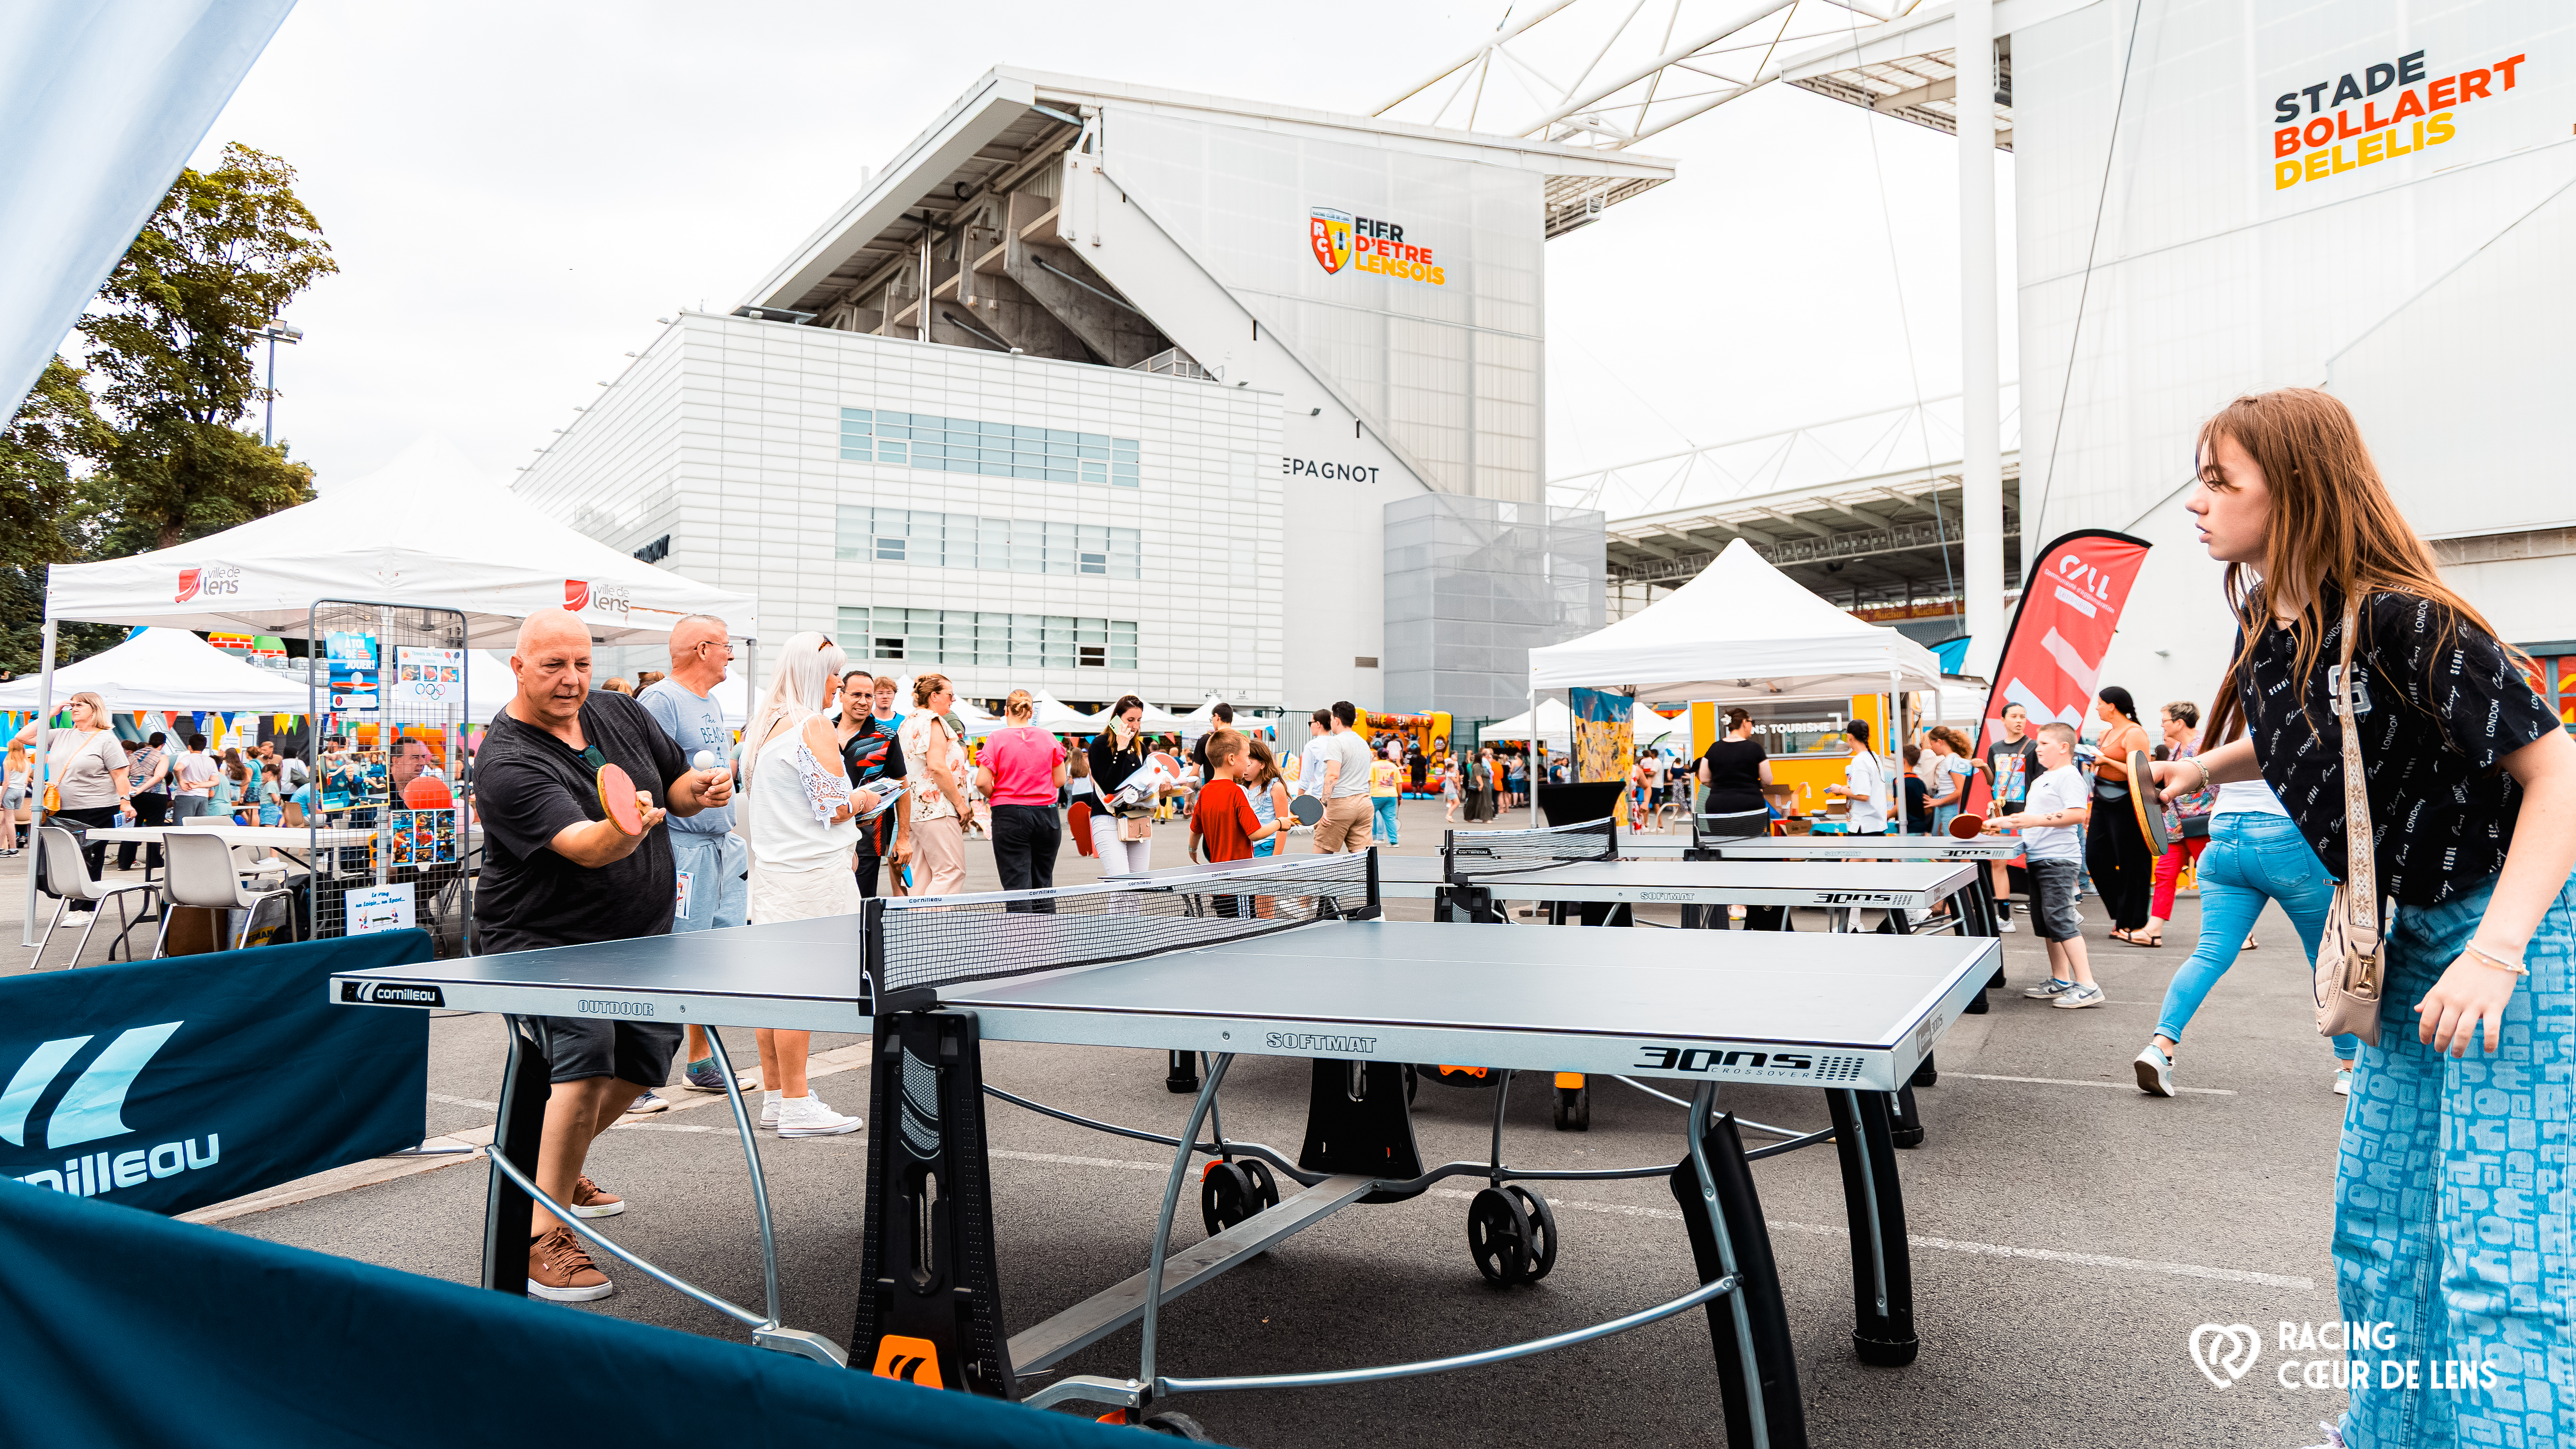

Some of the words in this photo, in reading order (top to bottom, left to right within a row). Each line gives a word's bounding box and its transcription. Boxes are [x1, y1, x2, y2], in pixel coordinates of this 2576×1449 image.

[2275, 49, 2426, 124] STADE
[2275, 54, 2525, 158] BOLLAERT
[2275, 112, 2456, 191] DELELIS
[1355, 216, 1404, 243] FIER
[1355, 251, 1446, 285] LENSOIS
[208, 567, 225, 578] ville
[227, 566, 240, 577] de
[2059, 555, 2110, 601] CALL
[204, 577, 239, 595] lens
[596, 584, 614, 595] ville
[616, 586, 629, 598] de
[593, 591, 629, 613] lens
[2415, 598, 2429, 633] LONDON
[345, 636, 351, 649] À
[351, 639, 365, 649] TOI
[345, 649, 357, 659] DE
[345, 659, 375, 670] JOUER!
[2254, 657, 2272, 673] Paris
[2408, 646, 2421, 671] Paris
[2450, 650, 2464, 675] SEOUL
[2269, 678, 2290, 696] SEOUL
[2441, 685, 2461, 720] Chicago
[1391, 715, 1431, 726] JUNGLE
[1769, 722, 1831, 734] TOURISME
[2485, 699, 2499, 738] LONDON
[700, 726, 727, 744] BEACH
[2297, 728, 2319, 756] LONDON
[2381, 714, 2398, 750] LONDON
[2322, 763, 2336, 782] Paris
[2368, 760, 2383, 780] Paris
[2405, 798, 2426, 833] LONDON
[2396, 843, 2409, 866] Paris
[2442, 847, 2457, 871] SEOUL
[1640, 892, 1695, 901] SOFTMAT
[376, 988, 436, 1002] cornilleau
[577, 999, 655, 1017] OUTDOOR
[1266, 1032, 1377, 1054] SOFTMAT
[1710, 1067, 1811, 1079] CROSSOVER
[12, 1133, 219, 1198] nilleau
